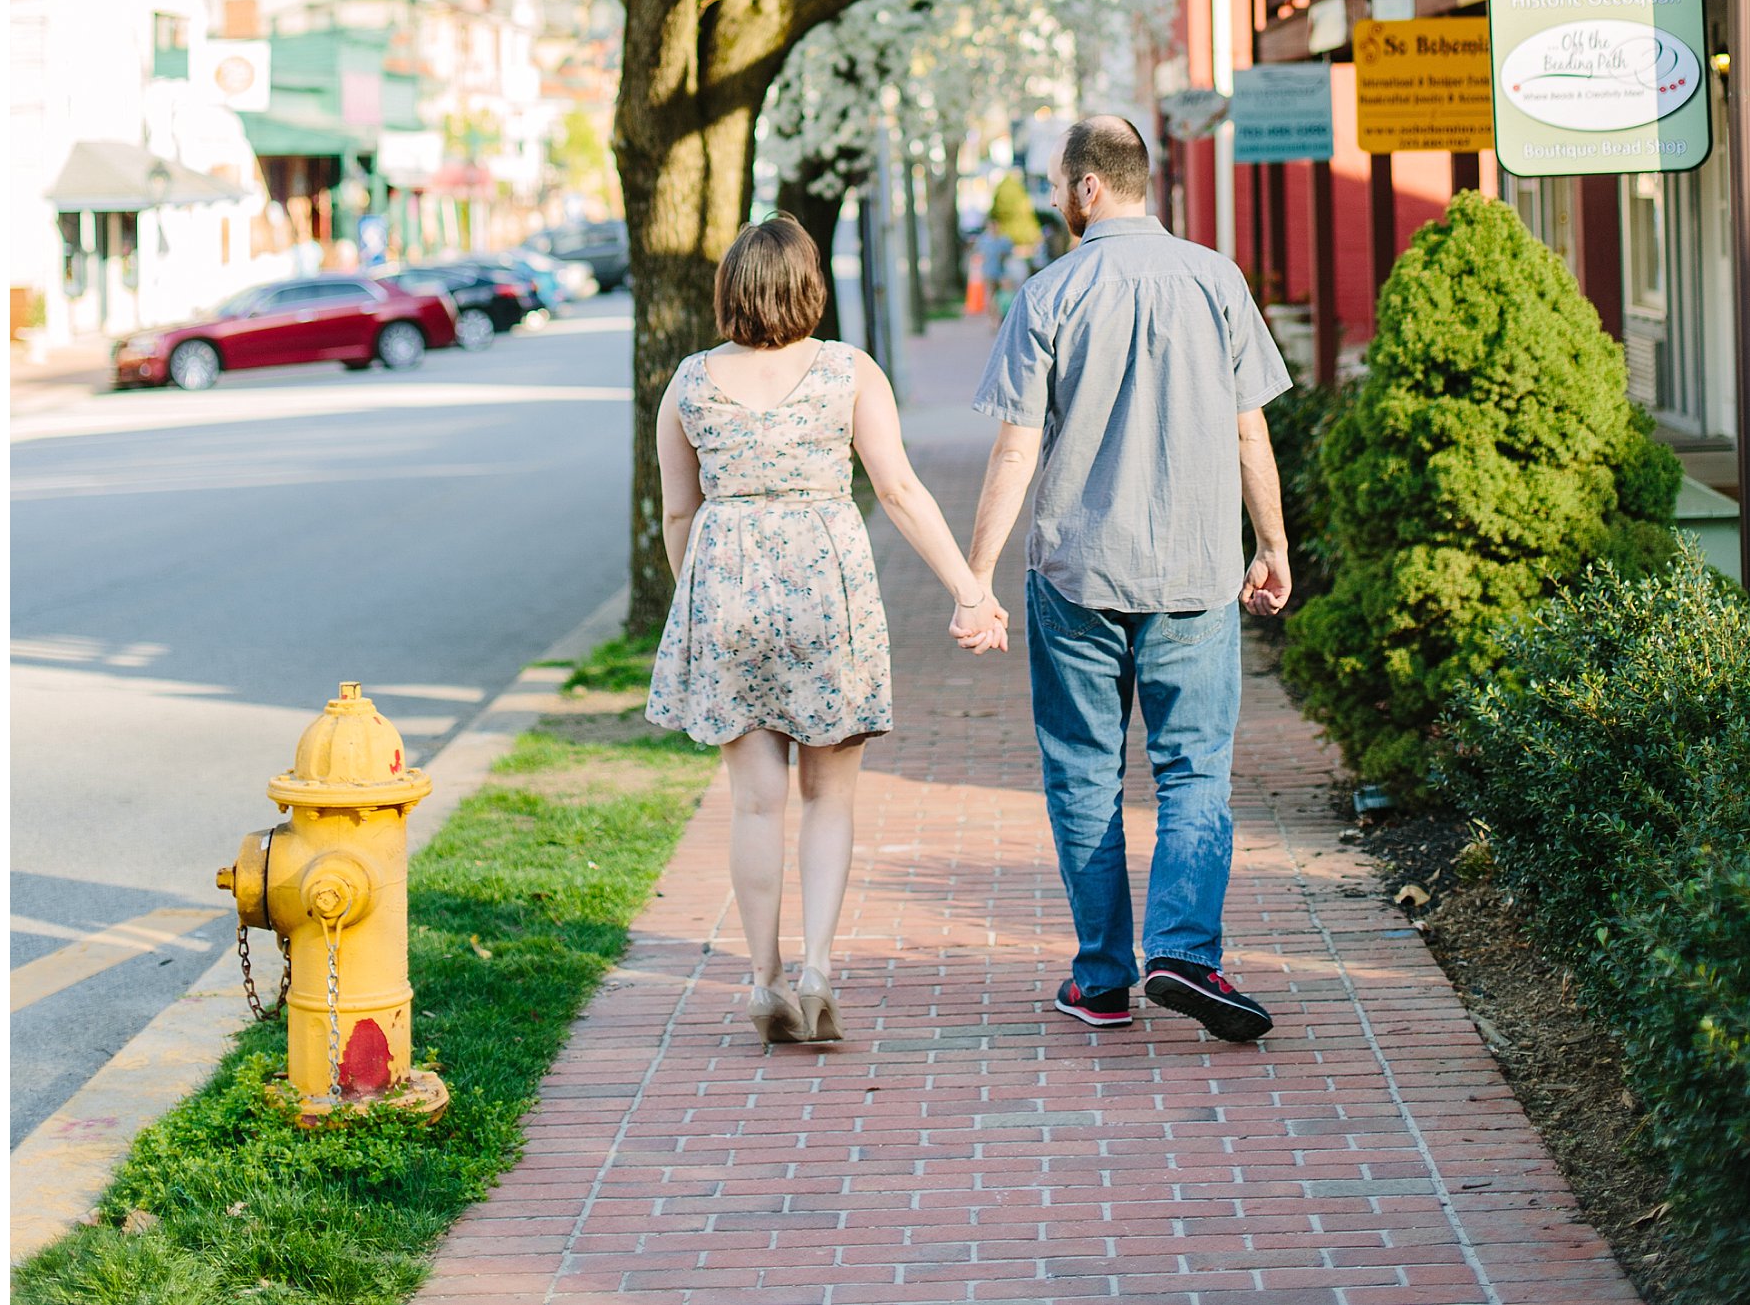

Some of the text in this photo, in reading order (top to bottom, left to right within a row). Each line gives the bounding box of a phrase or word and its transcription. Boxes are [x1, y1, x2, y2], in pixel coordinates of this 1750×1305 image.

[1383, 35, 1408, 56] So
[1562, 30, 1585, 54] Off
[1589, 29, 1611, 49] the
[1543, 49, 1627, 79] Beading Path
[1522, 138, 1688, 160] Boutique Bead Shop
